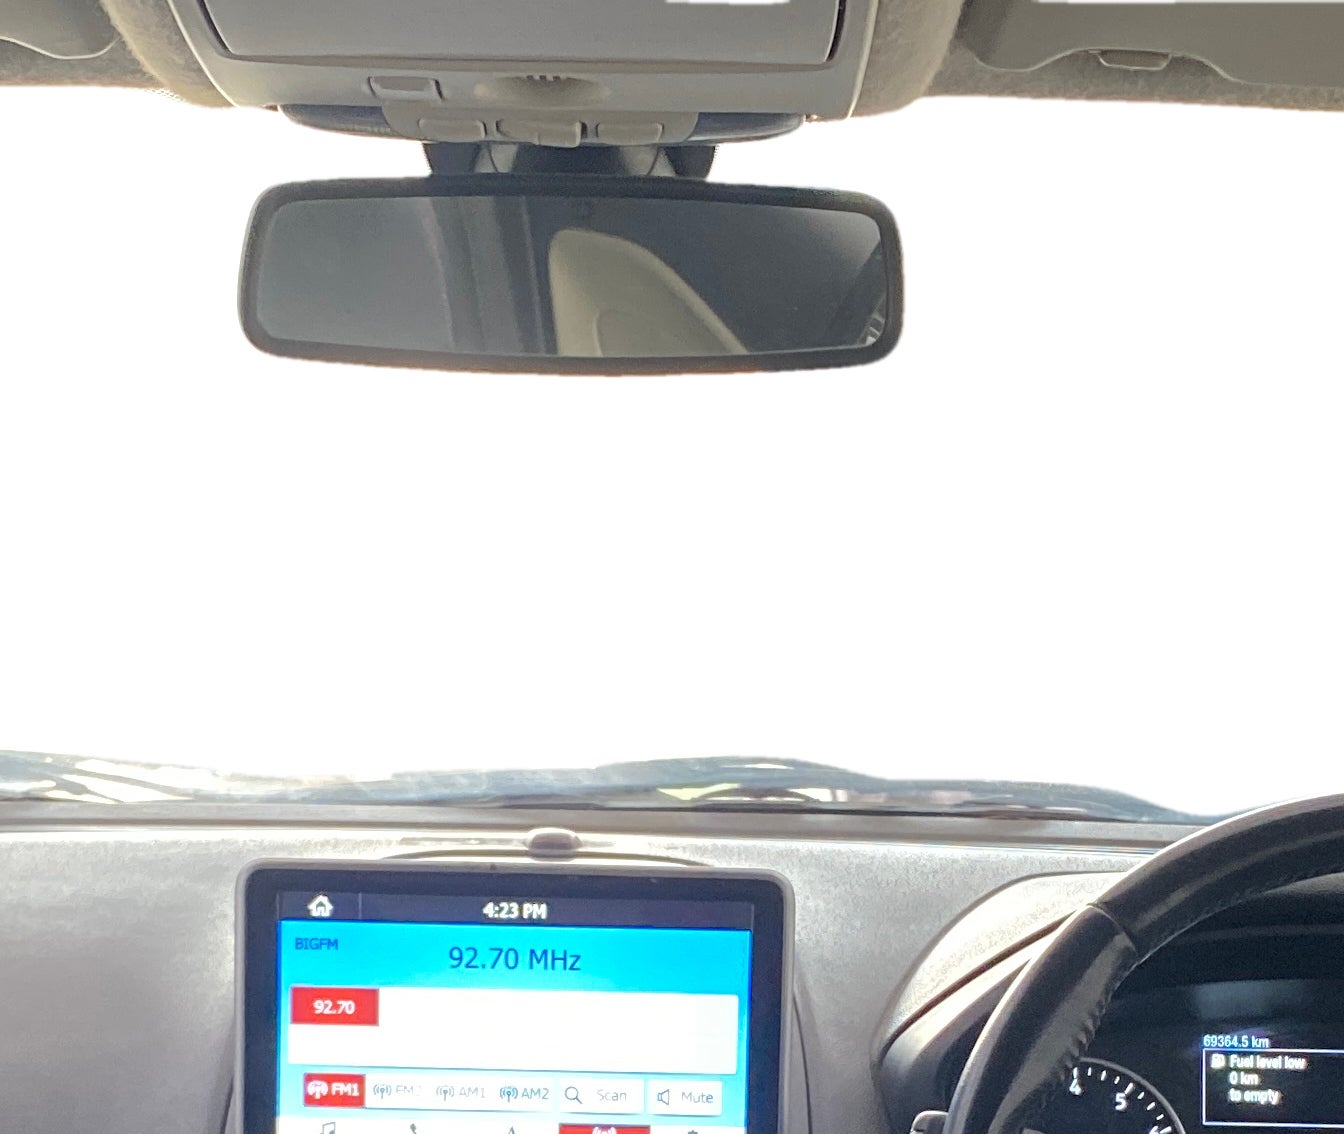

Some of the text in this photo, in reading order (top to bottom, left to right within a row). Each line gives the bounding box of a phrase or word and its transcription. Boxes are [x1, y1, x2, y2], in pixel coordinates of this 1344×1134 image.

[482, 901, 548, 920] 4:23 PM
[294, 937, 339, 951] BIGFM
[448, 946, 582, 972] 92.70 MHz
[312, 999, 356, 1015] 92.70
[1203, 1034, 1270, 1049] 69364.5 km
[1229, 1053, 1307, 1070] Fuel level low
[1229, 1071, 1258, 1085] 0 km
[330, 1082, 360, 1097] FM1
[458, 1083, 486, 1099] AM1
[521, 1086, 550, 1101] AM2
[596, 1088, 627, 1102] Scan
[1068, 1078, 1083, 1096] 4
[681, 1090, 714, 1104] Mute
[1115, 1092, 1128, 1112] 5
[1229, 1088, 1280, 1105] to empty
